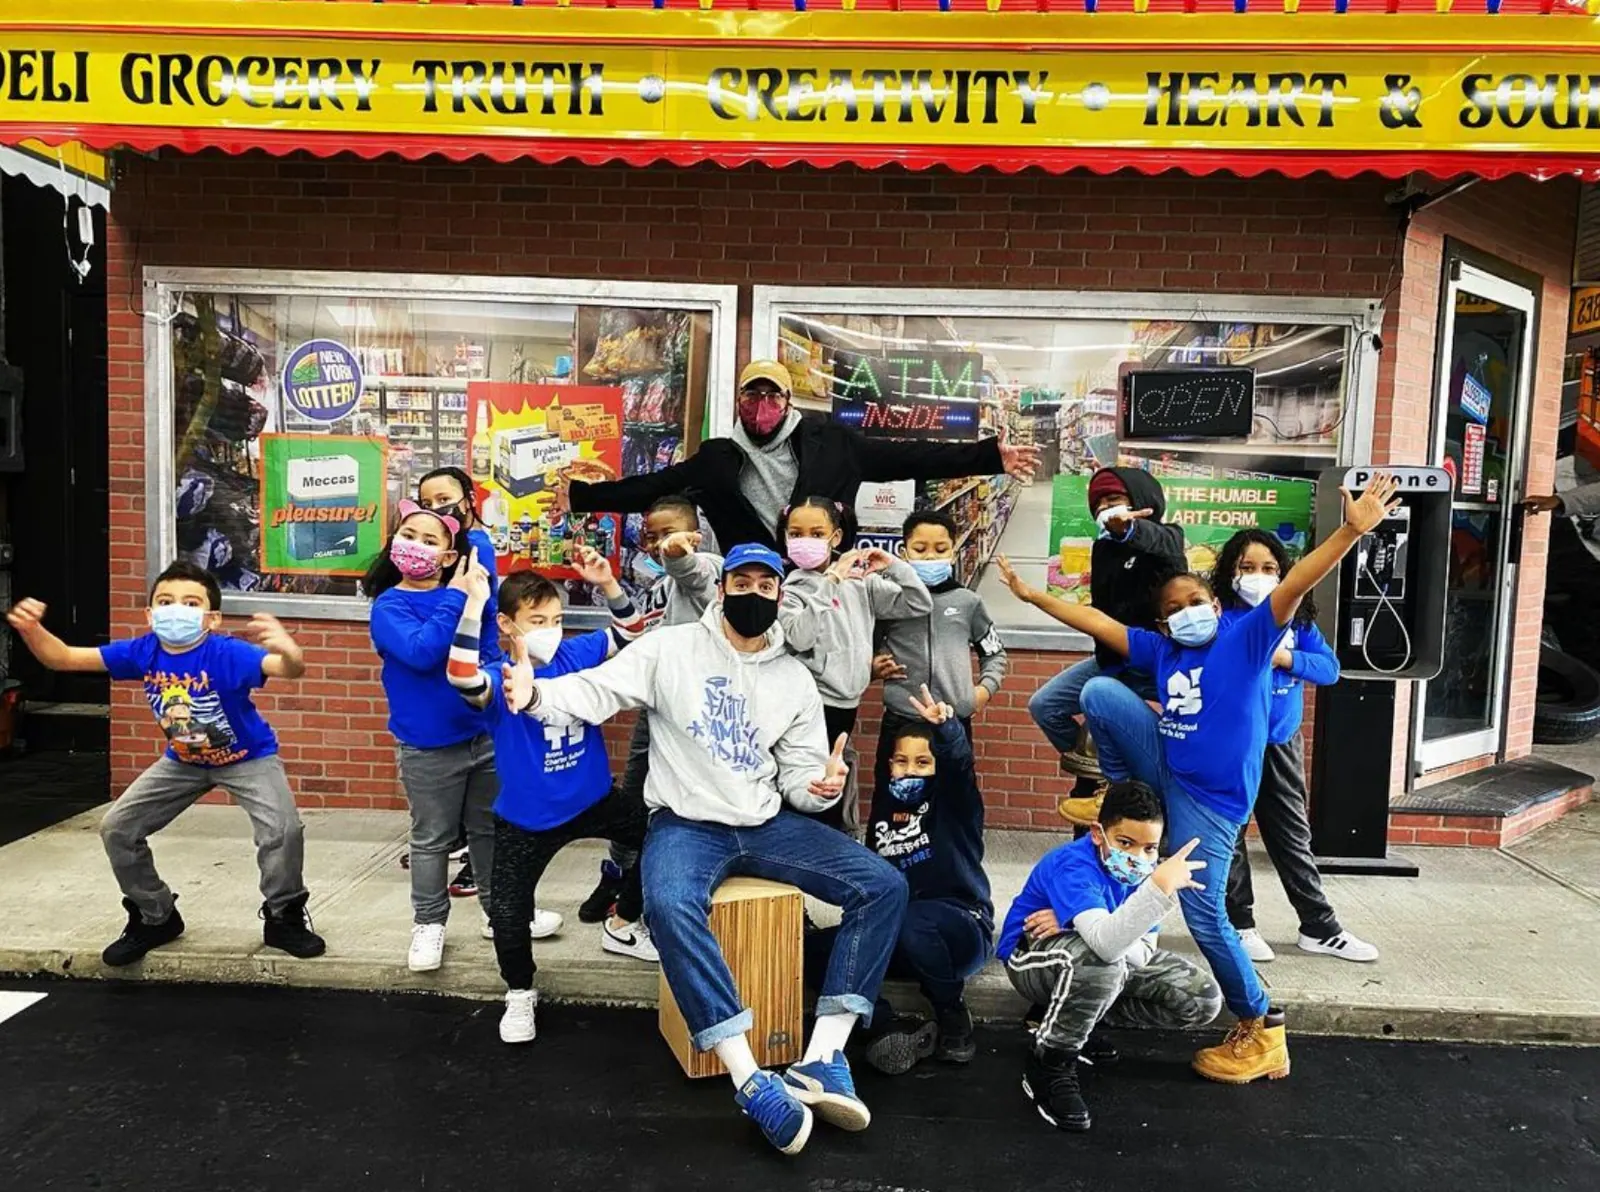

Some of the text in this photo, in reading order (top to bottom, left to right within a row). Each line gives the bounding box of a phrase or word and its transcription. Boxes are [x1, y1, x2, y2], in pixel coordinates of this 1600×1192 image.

[0, 51, 88, 103] ELI
[120, 53, 381, 105] GROCERY
[413, 59, 605, 116] TRUTH
[708, 67, 1049, 122] CREATIVITY
[1145, 71, 1346, 127] HEART
[1379, 75, 1423, 129] &
[320, 350, 345, 363] NEW
[322, 364, 353, 382] YORK
[842, 357, 973, 398] ATM
[292, 381, 356, 409] LOTTERY
[1138, 386, 1246, 417] OPEN
[861, 402, 950, 429] INSIDE
[302, 474, 355, 488] Meccas
[1355, 471, 1438, 487] Pone
[875, 495, 897, 504] WIC
[1172, 487, 1208, 502] THE
[1209, 488, 1278, 505] HUMBLE
[270, 502, 378, 528] pleasure!
[1171, 509, 1207, 525] ART
[1208, 511, 1260, 527] FORM.
